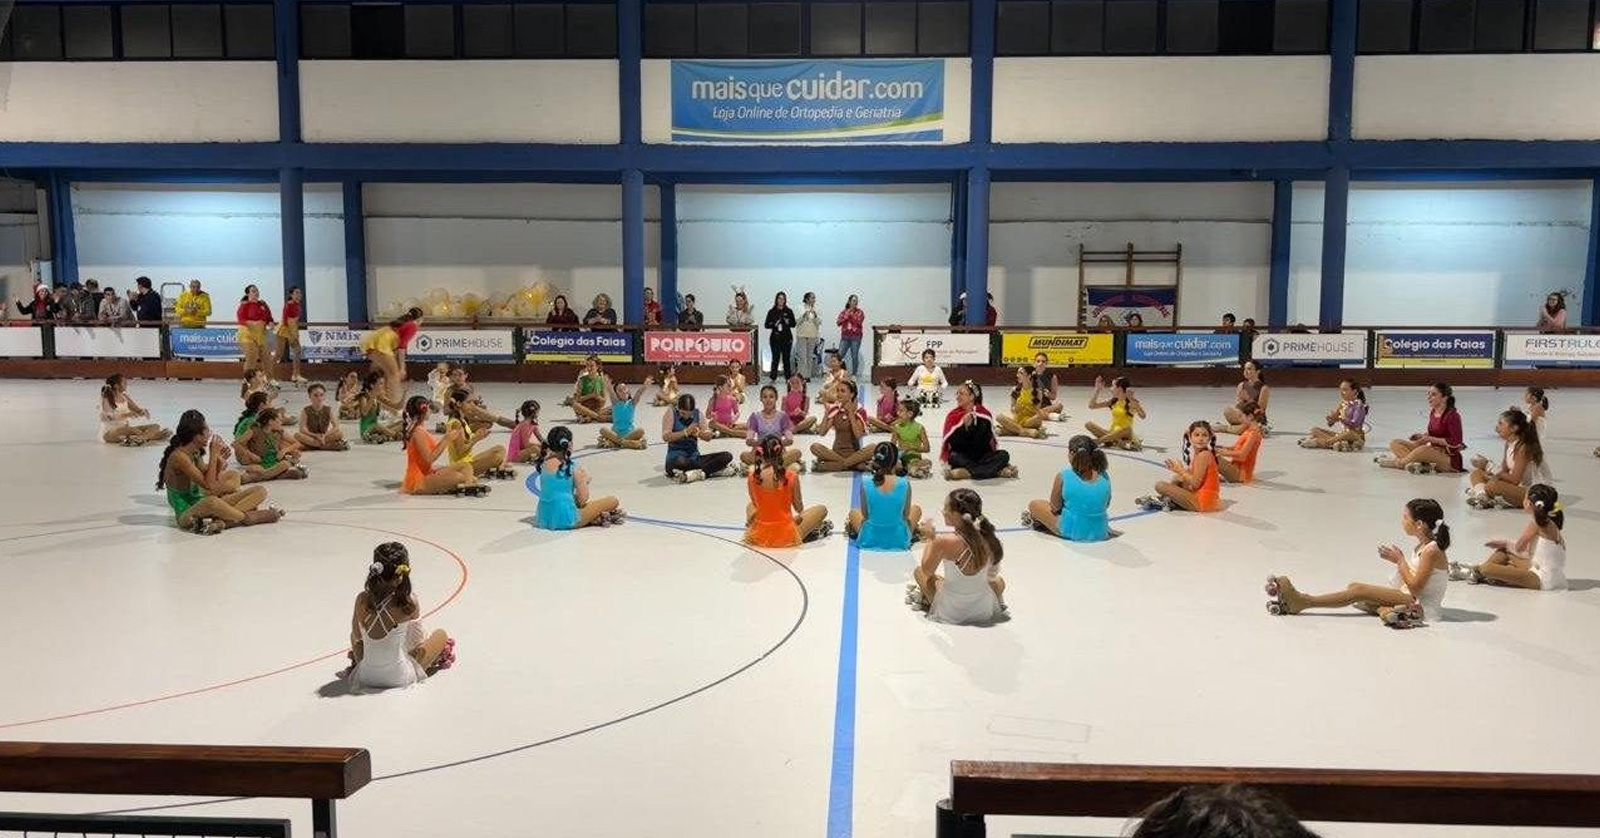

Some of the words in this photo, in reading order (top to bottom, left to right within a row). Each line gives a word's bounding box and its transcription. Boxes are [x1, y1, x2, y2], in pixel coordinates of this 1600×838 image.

[712, 106, 735, 122] Loja
[737, 106, 772, 119] Online
[775, 106, 789, 119] de
[790, 106, 844, 121] Ortopedia
[846, 109, 853, 119] e
[855, 106, 901, 119] Geriatria
[435, 338, 503, 348] PRIMEHOUSE
[576, 336, 595, 346] das
[596, 336, 626, 346] Faias
[926, 340, 943, 348] FPP
[1431, 339, 1453, 349] das
[1454, 338, 1486, 349] Faias
[1283, 342, 1355, 352] PRIMEHOUSE
